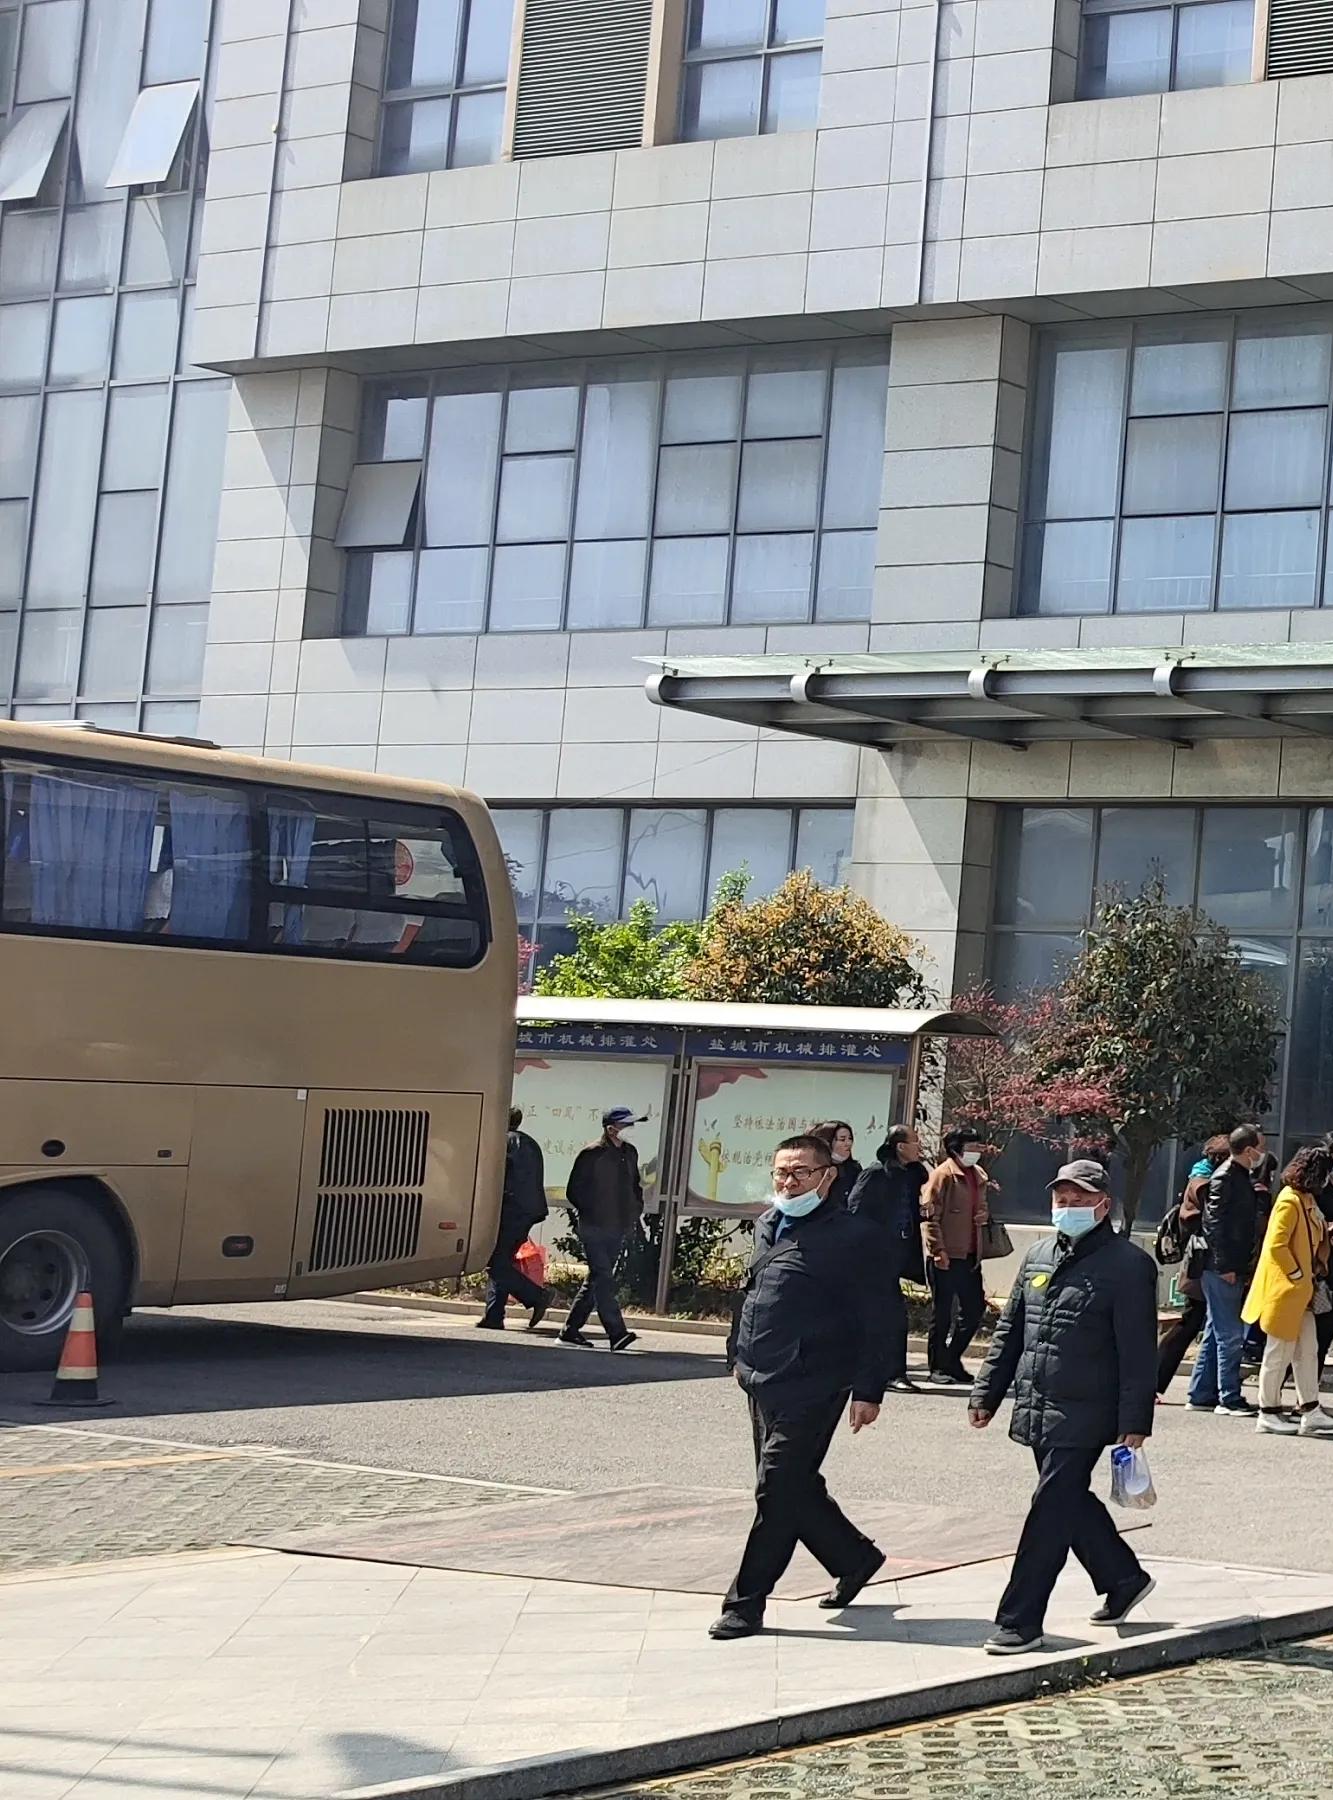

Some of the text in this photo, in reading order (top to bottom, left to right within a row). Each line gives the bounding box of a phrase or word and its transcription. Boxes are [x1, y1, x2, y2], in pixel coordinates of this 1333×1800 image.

[708, 1038, 882, 1058] 盐城市机械排灌处
